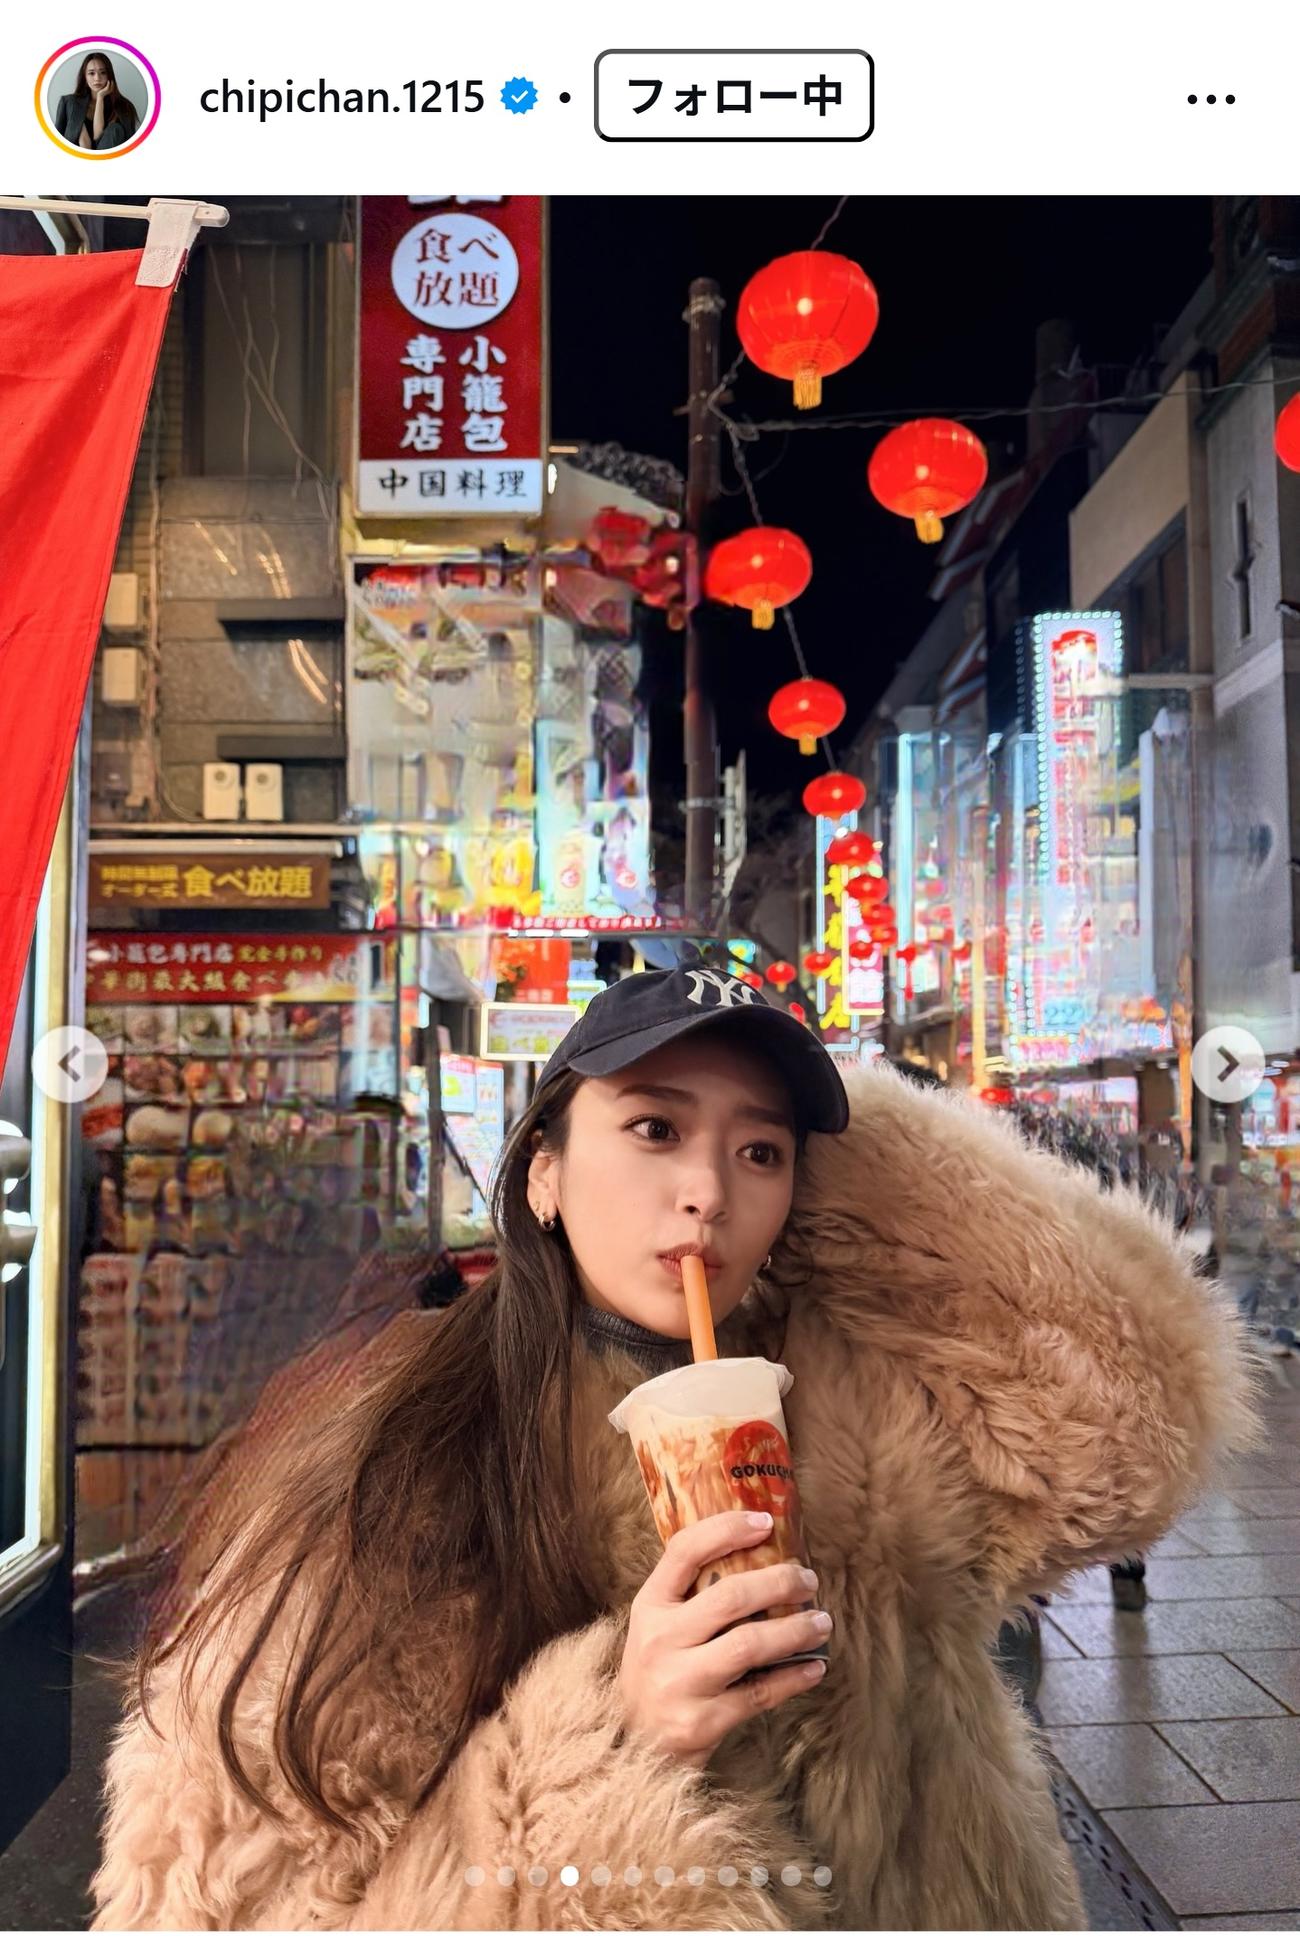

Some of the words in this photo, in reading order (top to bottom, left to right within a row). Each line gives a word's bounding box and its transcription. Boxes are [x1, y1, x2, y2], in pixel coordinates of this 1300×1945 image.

[415, 227, 500, 263] 食べ
[413, 270, 499, 308] 放題
[400, 333, 447, 452] 専門店
[457, 334, 509, 452] 小籠包
[378, 466, 528, 499] 中国料理
[183, 864, 314, 899] 食べ放題
[684, 969, 757, 1008] NY
